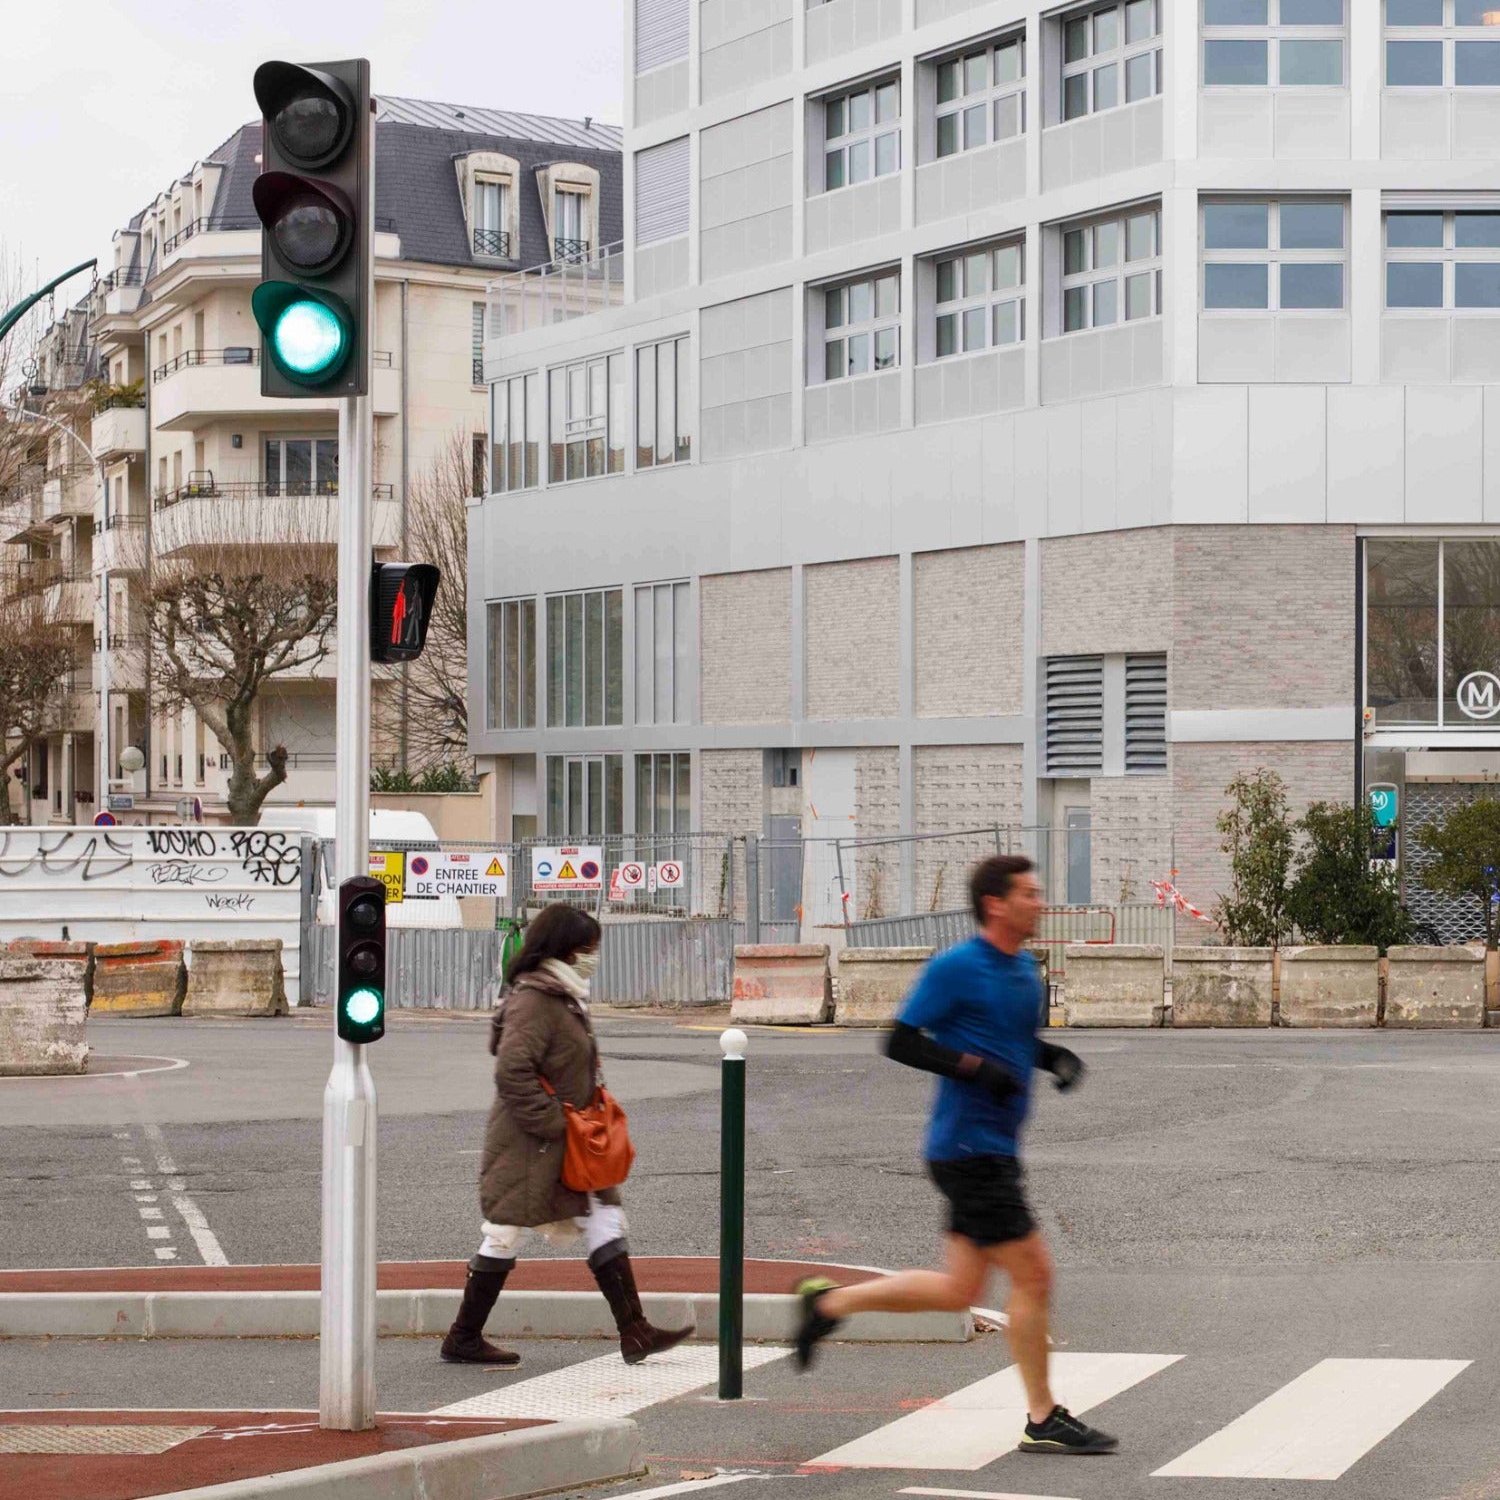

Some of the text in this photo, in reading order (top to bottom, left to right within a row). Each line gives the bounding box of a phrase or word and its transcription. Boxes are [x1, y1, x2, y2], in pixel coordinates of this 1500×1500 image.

[435, 868, 479, 881] ENTREE
[416, 882, 497, 895] DE CHANTIER
